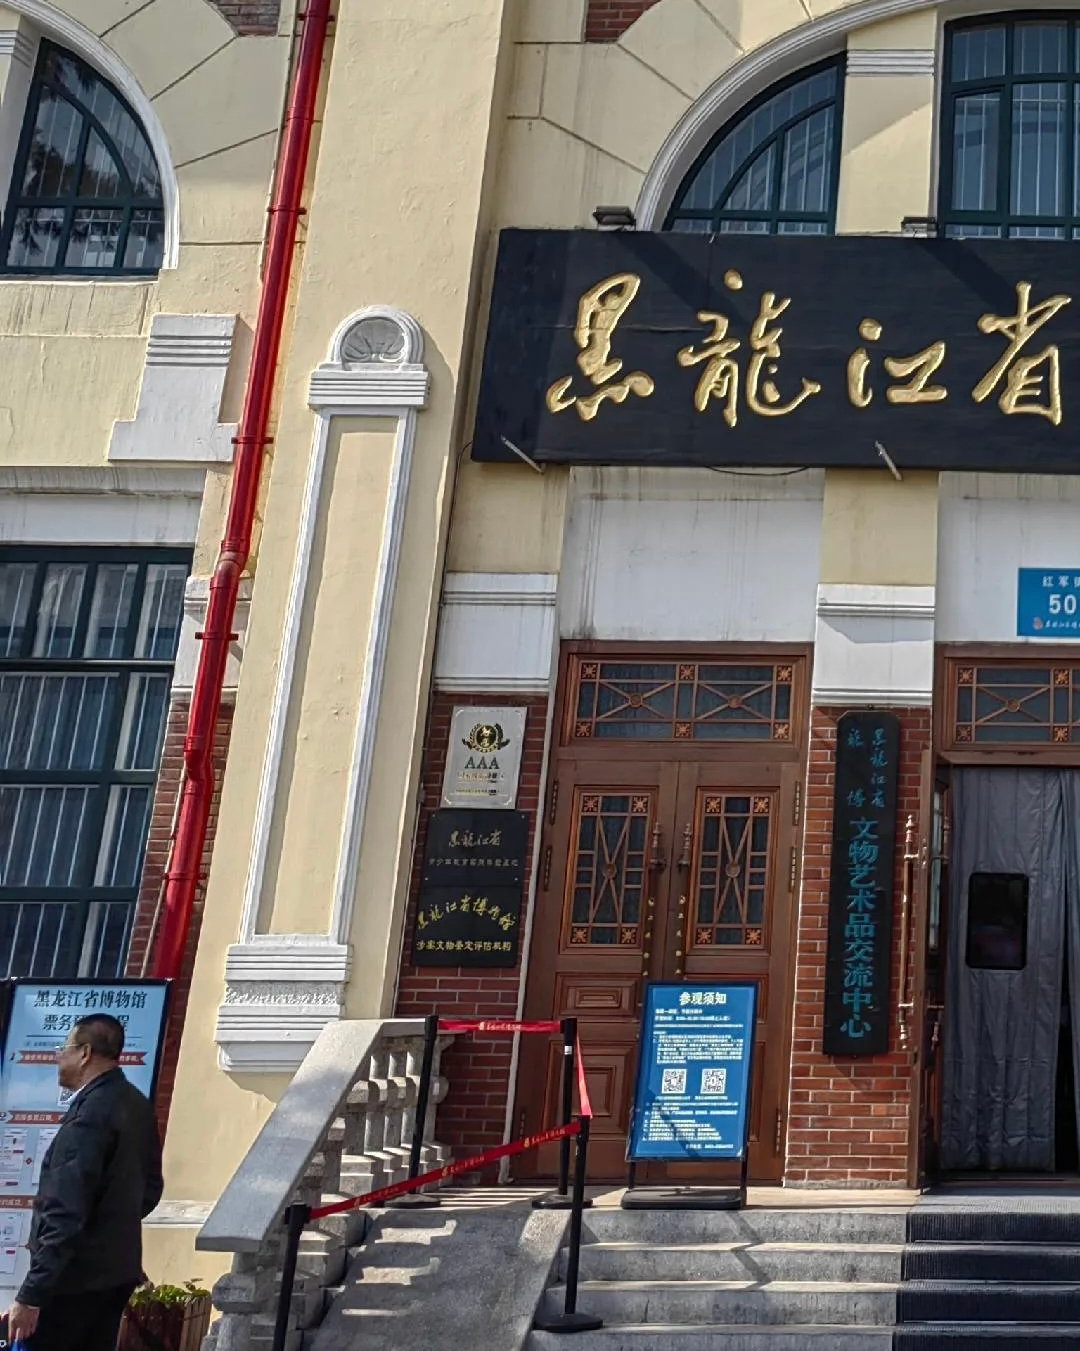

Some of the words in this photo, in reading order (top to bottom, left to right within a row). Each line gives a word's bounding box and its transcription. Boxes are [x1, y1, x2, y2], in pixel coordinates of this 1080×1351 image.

[1049, 594, 1077, 615] 50
[464, 756, 500, 769] AAA
[840, 817, 880, 1039] 文物艺术品交流中心
[34, 989, 148, 1009] 黑龙江省博物馆
[679, 991, 727, 1006] 参观须知
